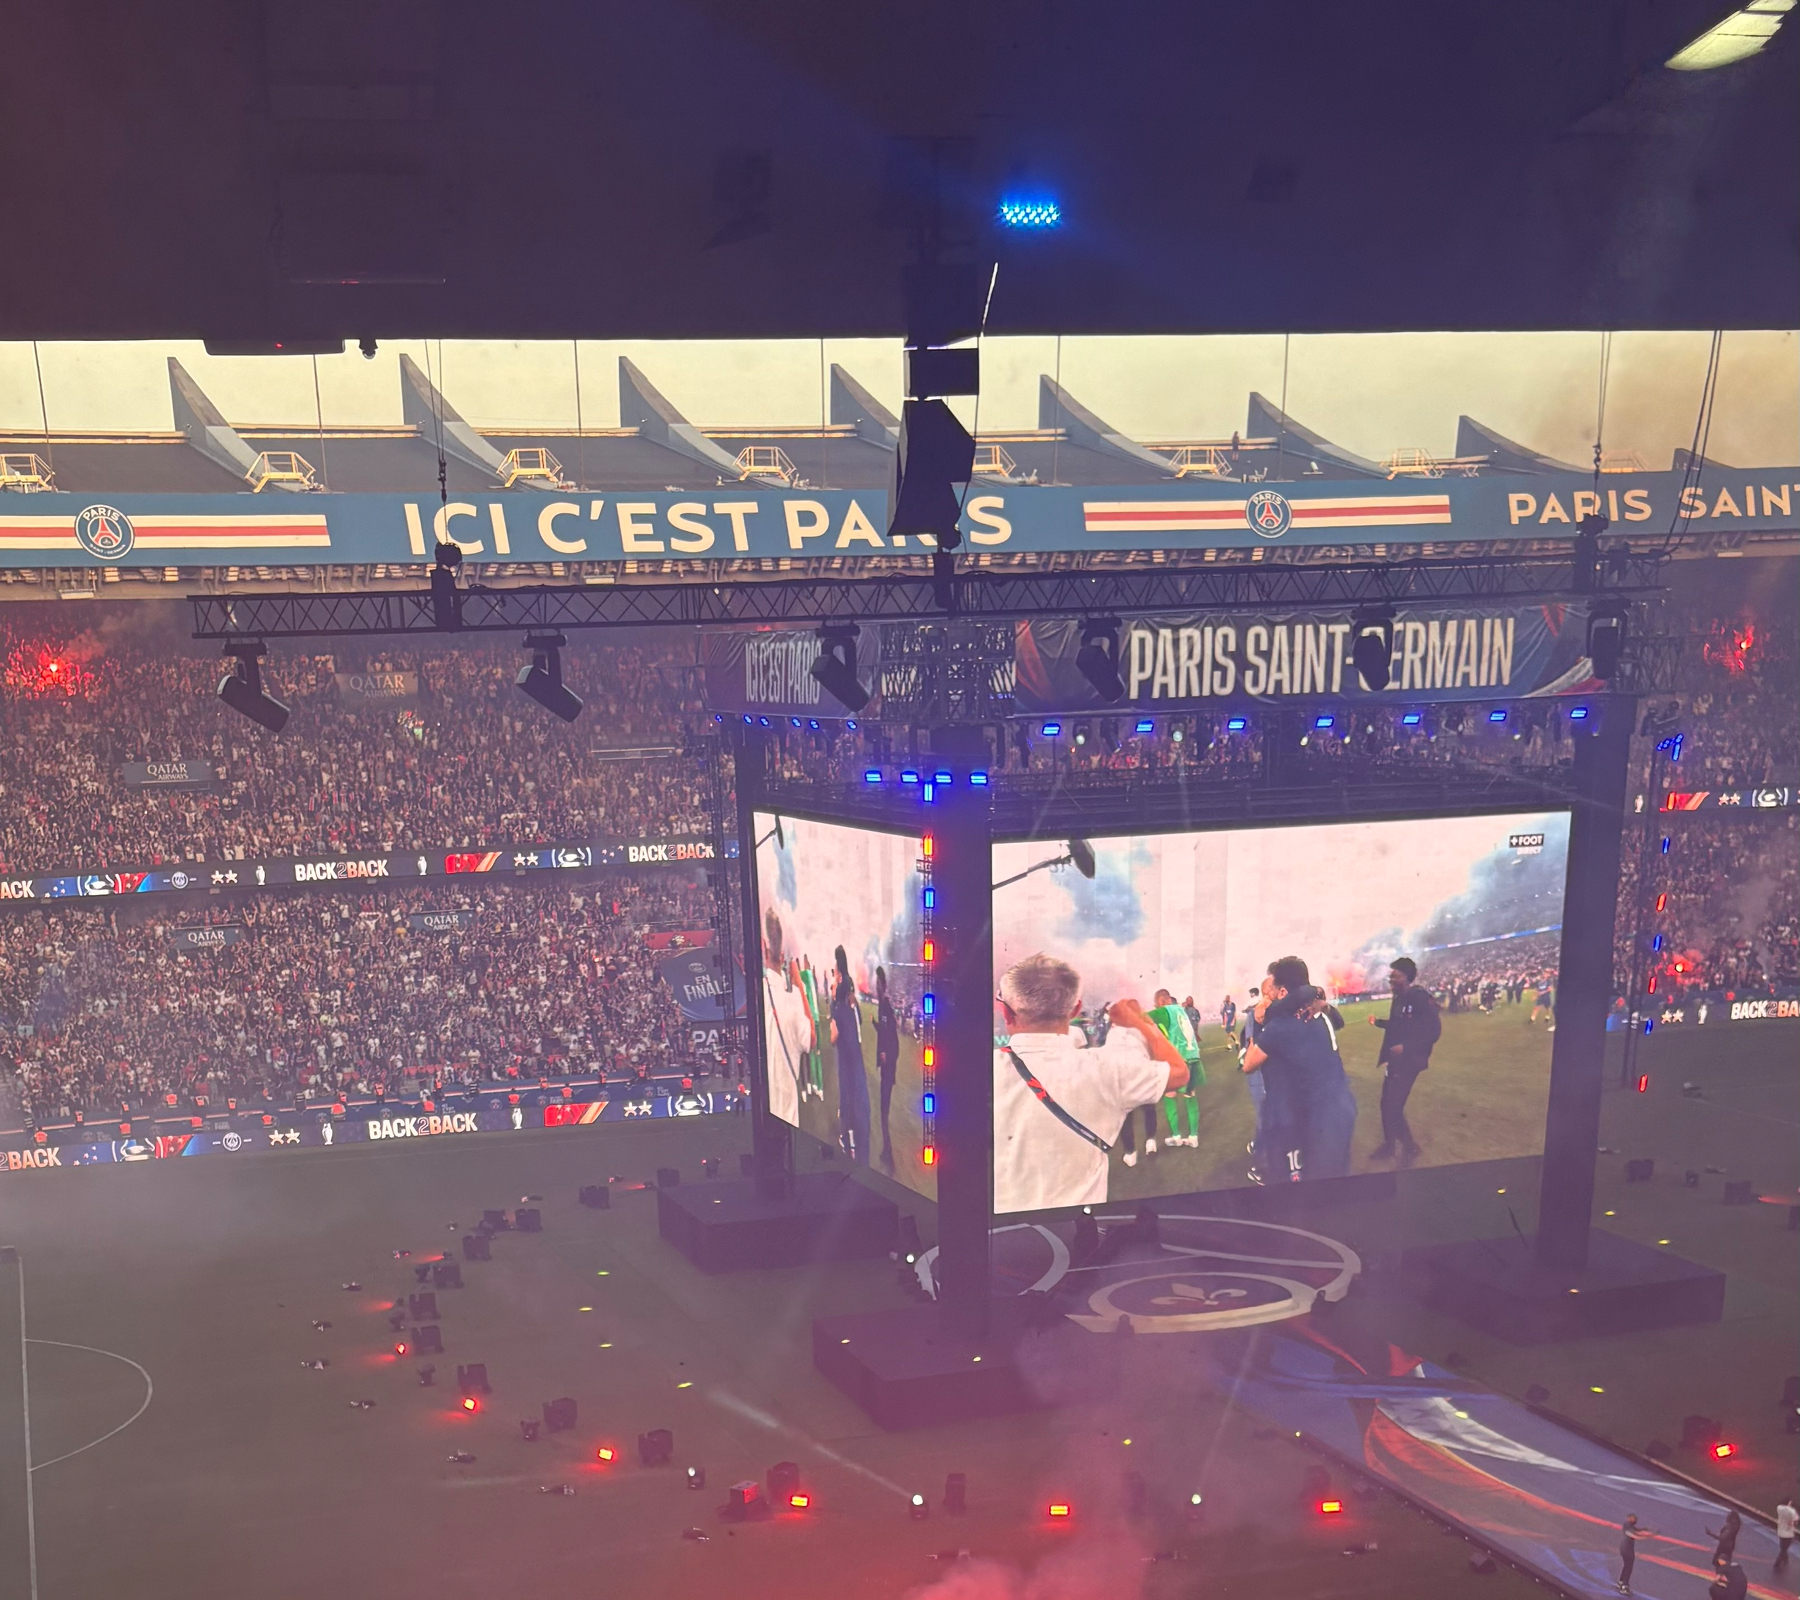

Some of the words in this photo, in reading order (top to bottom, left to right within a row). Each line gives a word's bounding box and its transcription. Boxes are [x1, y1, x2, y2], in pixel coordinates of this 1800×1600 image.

[1252, 493, 1282, 505] PARIS
[1508, 489, 1652, 525] PARIS
[83, 507, 120, 521] PARIS
[404, 502, 511, 555] ICI
[537, 500, 759, 553] C'EST
[783, 496, 1012, 549] PAS
[1129, 625, 1237, 699] PARIS
[1244, 617, 1514, 695] SAINT-ERMAIN
[349, 674, 405, 692] QATAR
[147, 763, 188, 776] QATAR
[628, 842, 715, 862] BACK2BACK
[294, 859, 389, 881] BACK2BACK
[424, 914, 459, 926] QATAR
[188, 930, 225, 943] QATAR
[695, 974, 710, 984] EN
[369, 1113, 478, 1140] BACK2BACK
